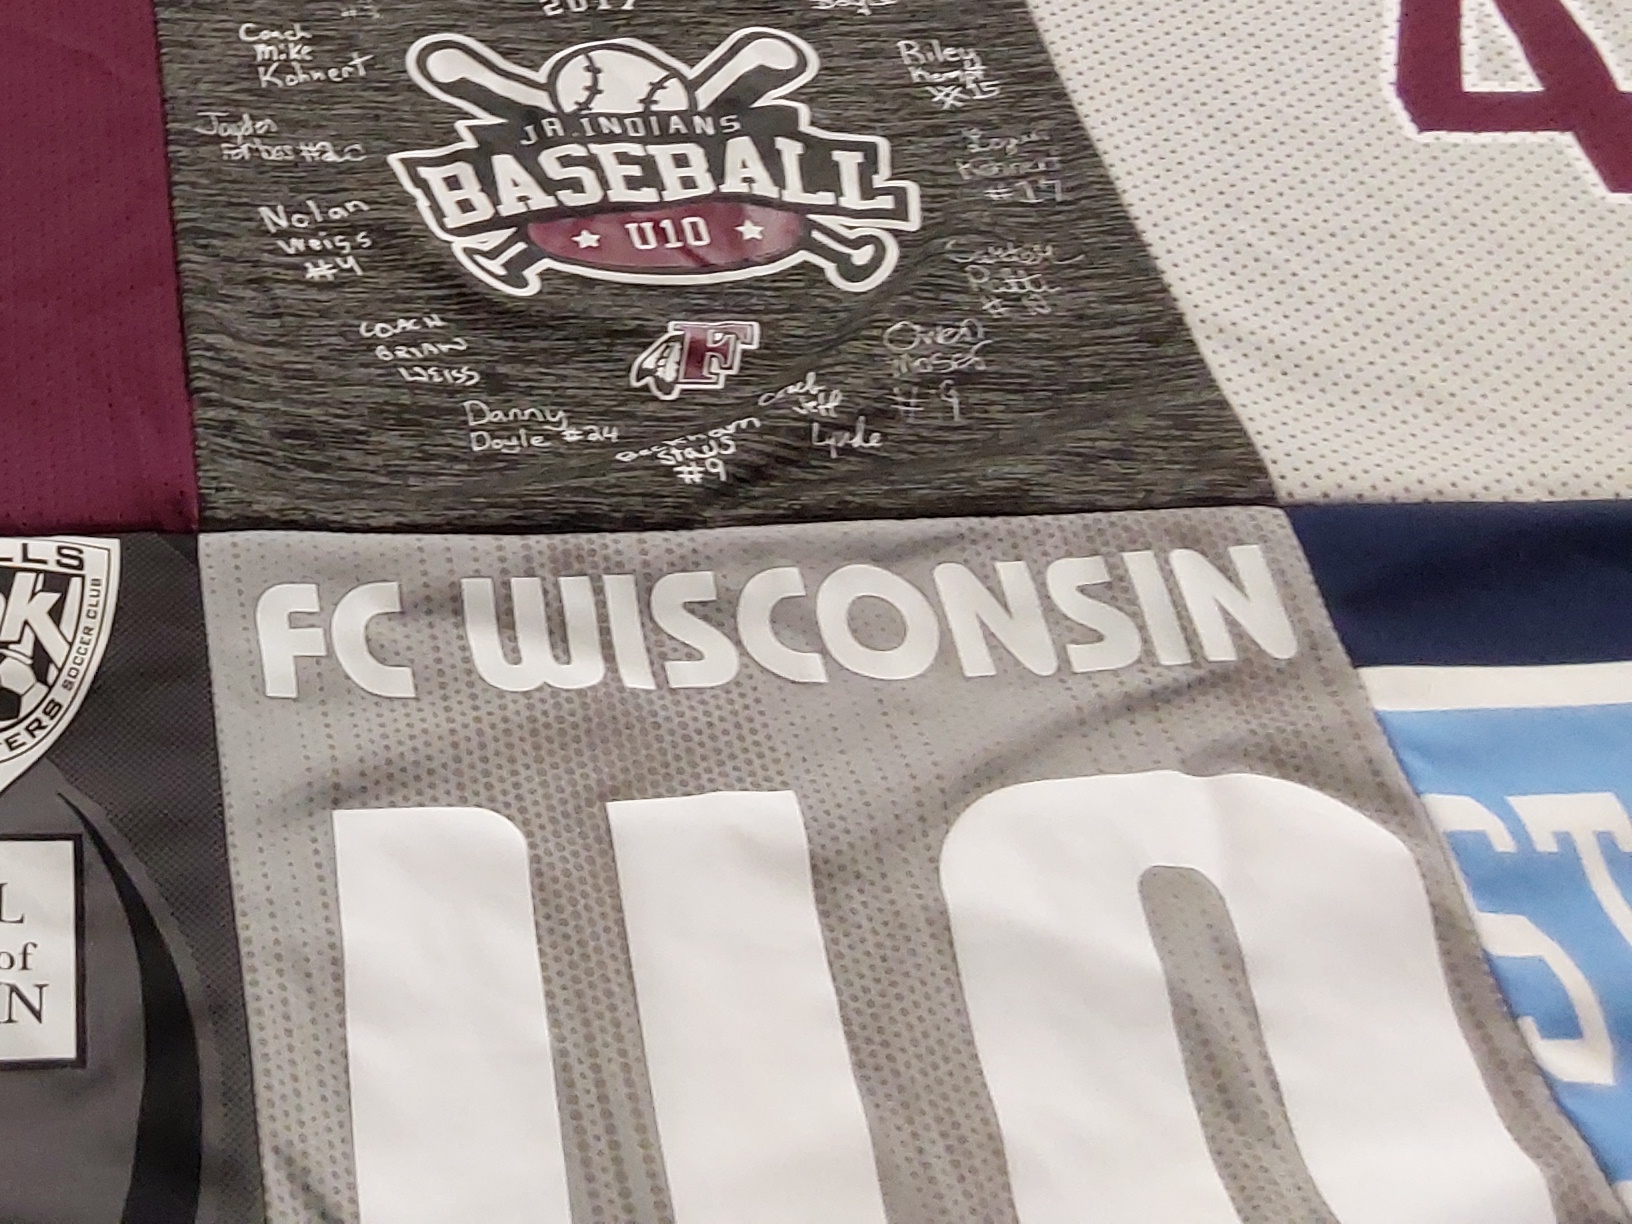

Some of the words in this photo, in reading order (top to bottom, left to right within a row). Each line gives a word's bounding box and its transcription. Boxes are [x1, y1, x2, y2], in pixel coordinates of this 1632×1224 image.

[895, 39, 989, 70] Riley
[583, 112, 742, 139] INDIANS
[416, 134, 897, 229] BASEBALL
[257, 198, 370, 233] Nolan
[276, 231, 374, 256] Weiss
[624, 216, 711, 251] U10
[304, 255, 365, 282] #4
[463, 399, 569, 432] Danny
[469, 429, 552, 454] Doyle
[672, 457, 728, 485] #9
[61, 625, 95, 692] SOCCER
[88, 577, 103, 622] CLUB
[255, 581, 416, 700] FC
[461, 543, 1301, 693] WISCONSIN
